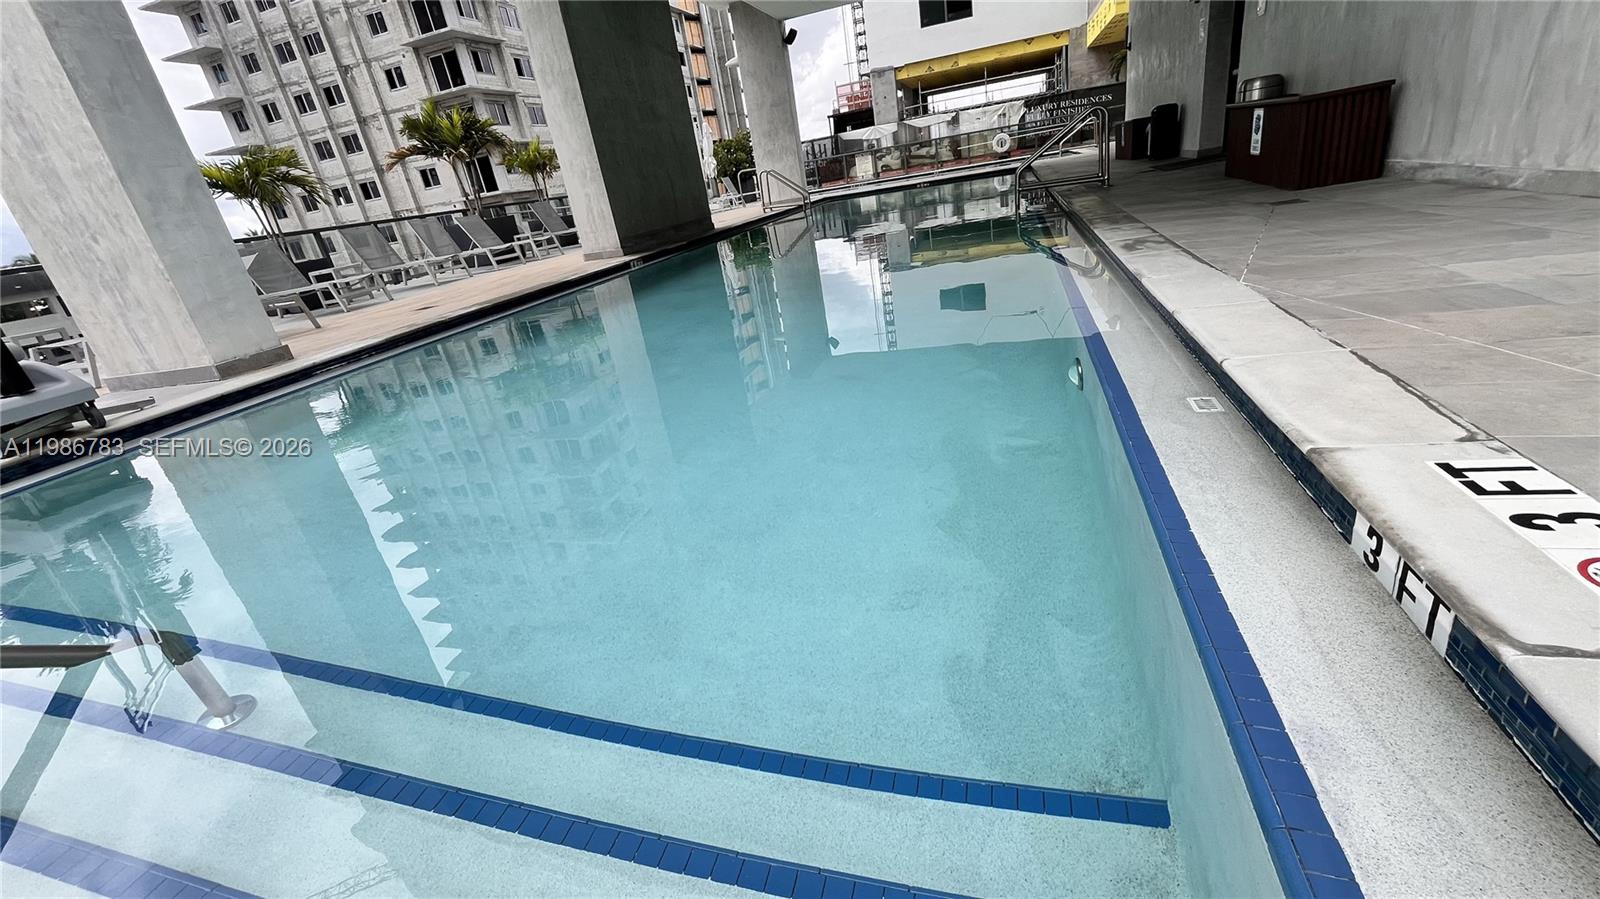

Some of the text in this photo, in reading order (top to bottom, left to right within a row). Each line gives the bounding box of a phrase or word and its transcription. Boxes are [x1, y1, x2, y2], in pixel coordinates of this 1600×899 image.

[1060, 94, 1112, 107] RESIDENCES
[1434, 462, 1600, 531] 3 FT
[1362, 525, 1452, 640] 3 FT
